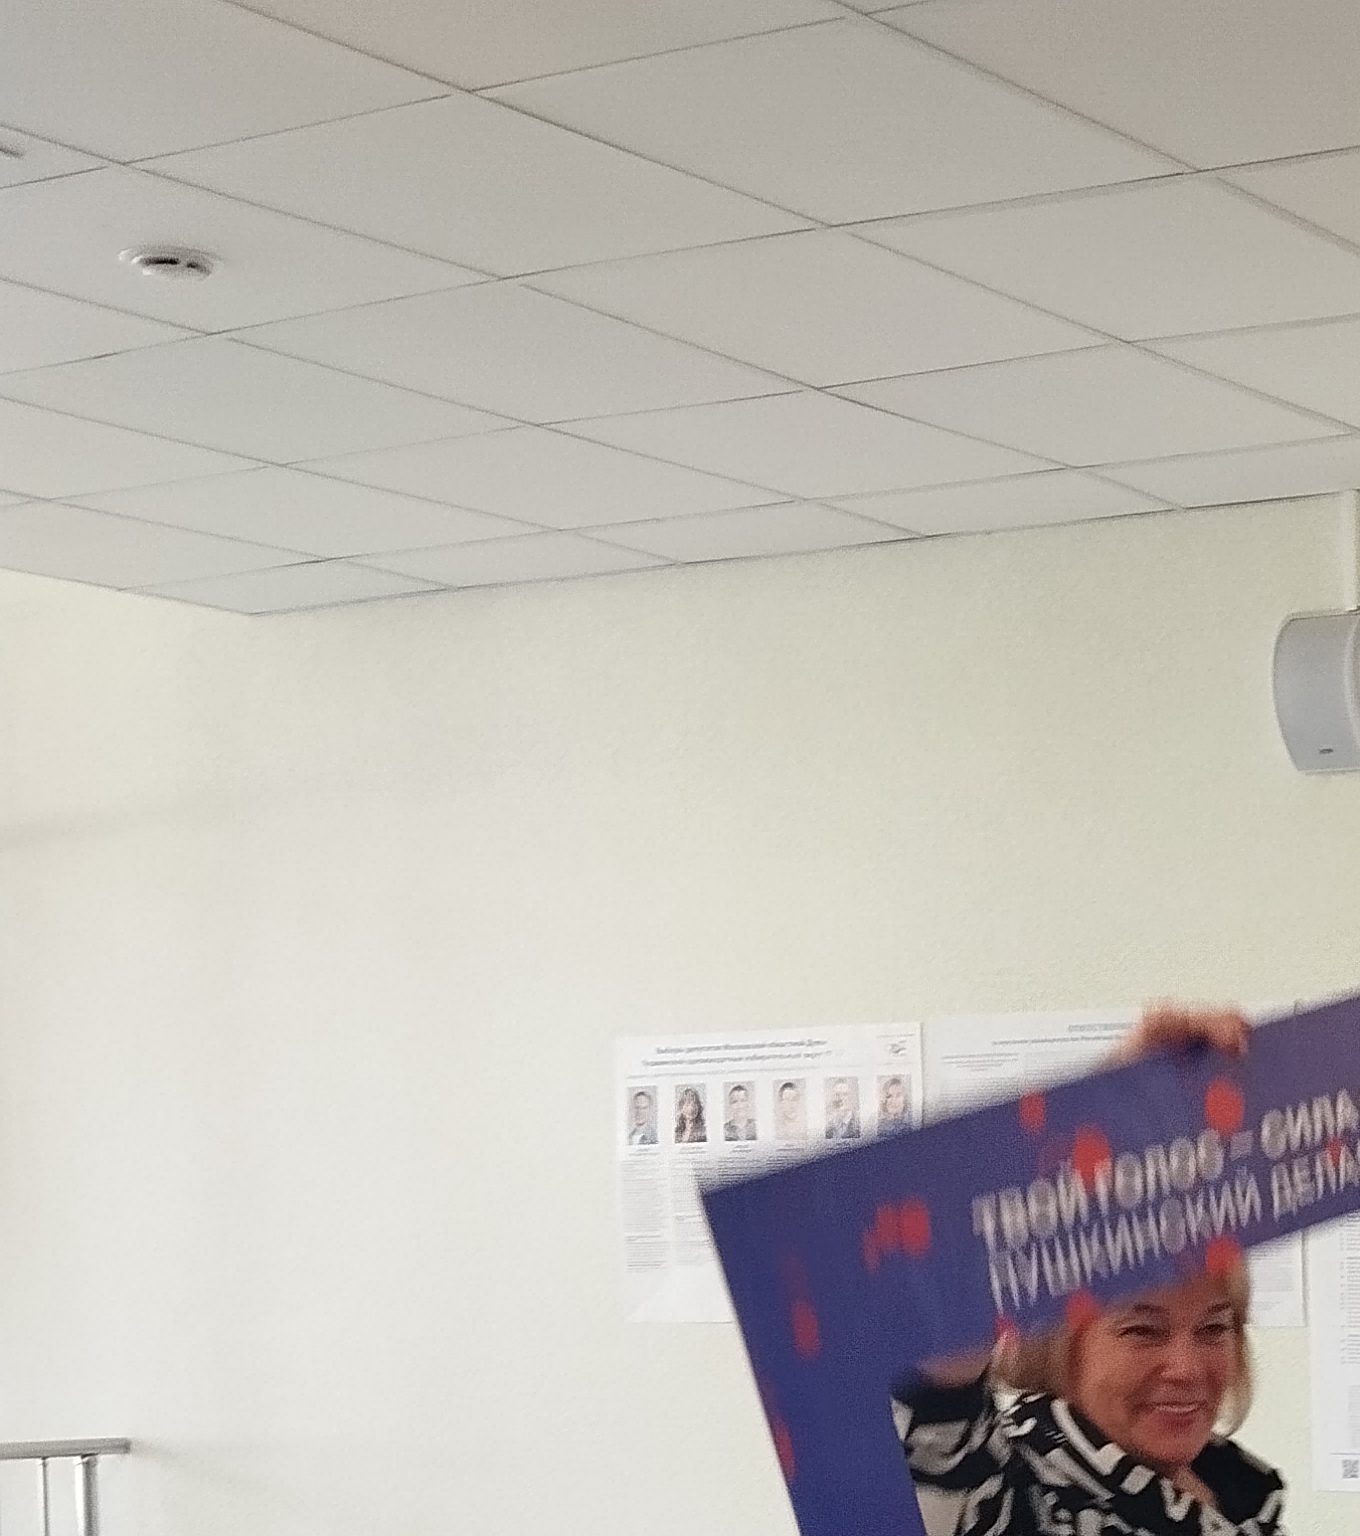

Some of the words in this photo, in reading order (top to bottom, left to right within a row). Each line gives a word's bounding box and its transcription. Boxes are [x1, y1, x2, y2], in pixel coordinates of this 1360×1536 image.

[972, 1160, 1089, 1250] ТВОЙ
[1094, 1128, 1225, 1217] ГОЛОС
[1261, 1087, 1359, 1160] СИЛА
[988, 1166, 1262, 1314] ПУШКИНСКИЙ
